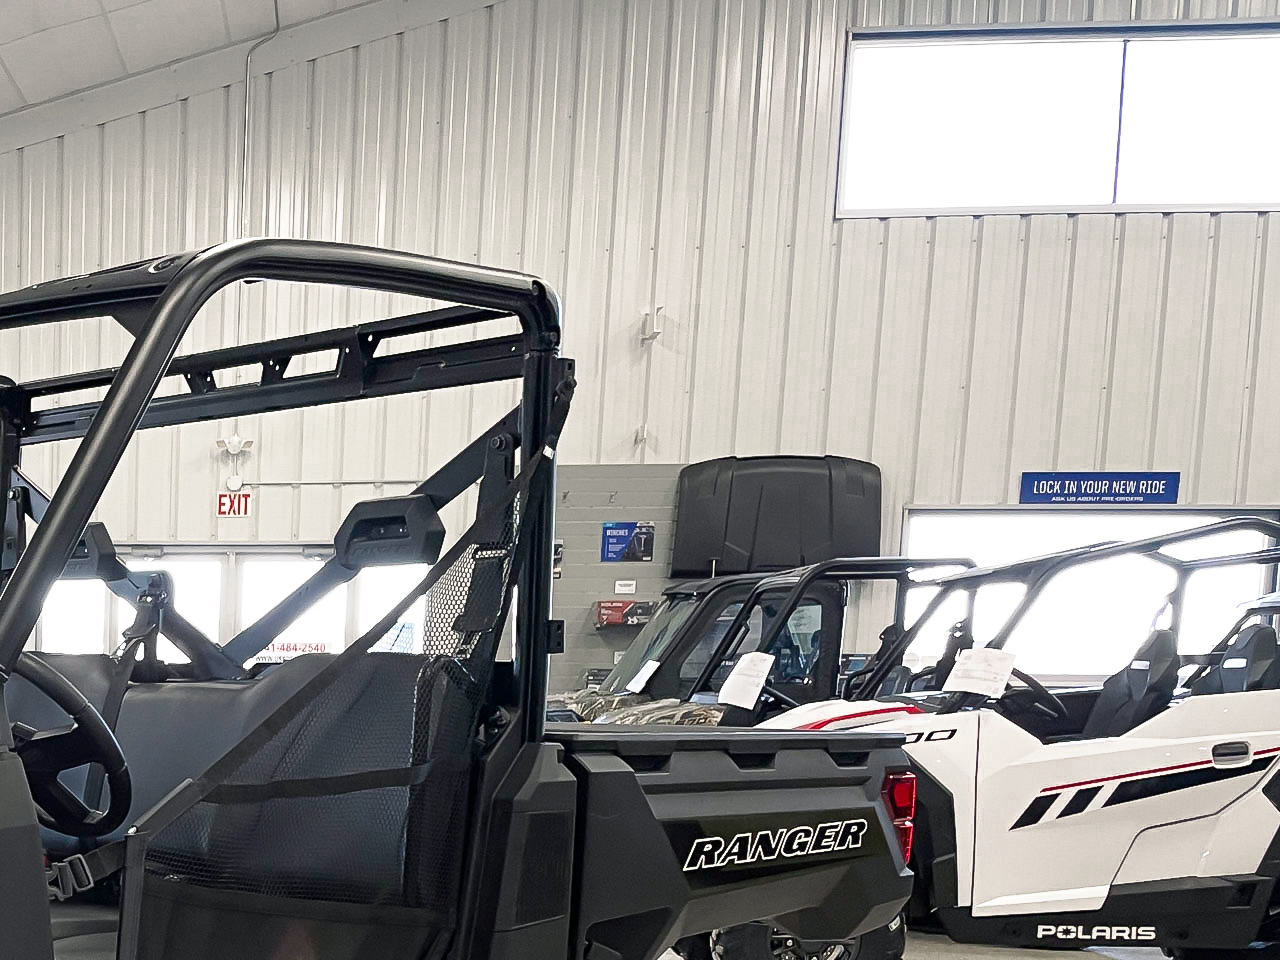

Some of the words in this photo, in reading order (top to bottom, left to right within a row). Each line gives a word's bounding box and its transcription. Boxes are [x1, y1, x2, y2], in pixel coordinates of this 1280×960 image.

[1033, 480, 1061, 494] LOCK
[1064, 480, 1077, 494] IN
[1081, 480, 1109, 494] YOUR
[1112, 480, 1136, 494] NEW
[1139, 480, 1166, 494] RIDE
[218, 493, 250, 515] EXIT
[682, 818, 868, 872] RANGER
[1037, 925, 1157, 940] POLARIS
